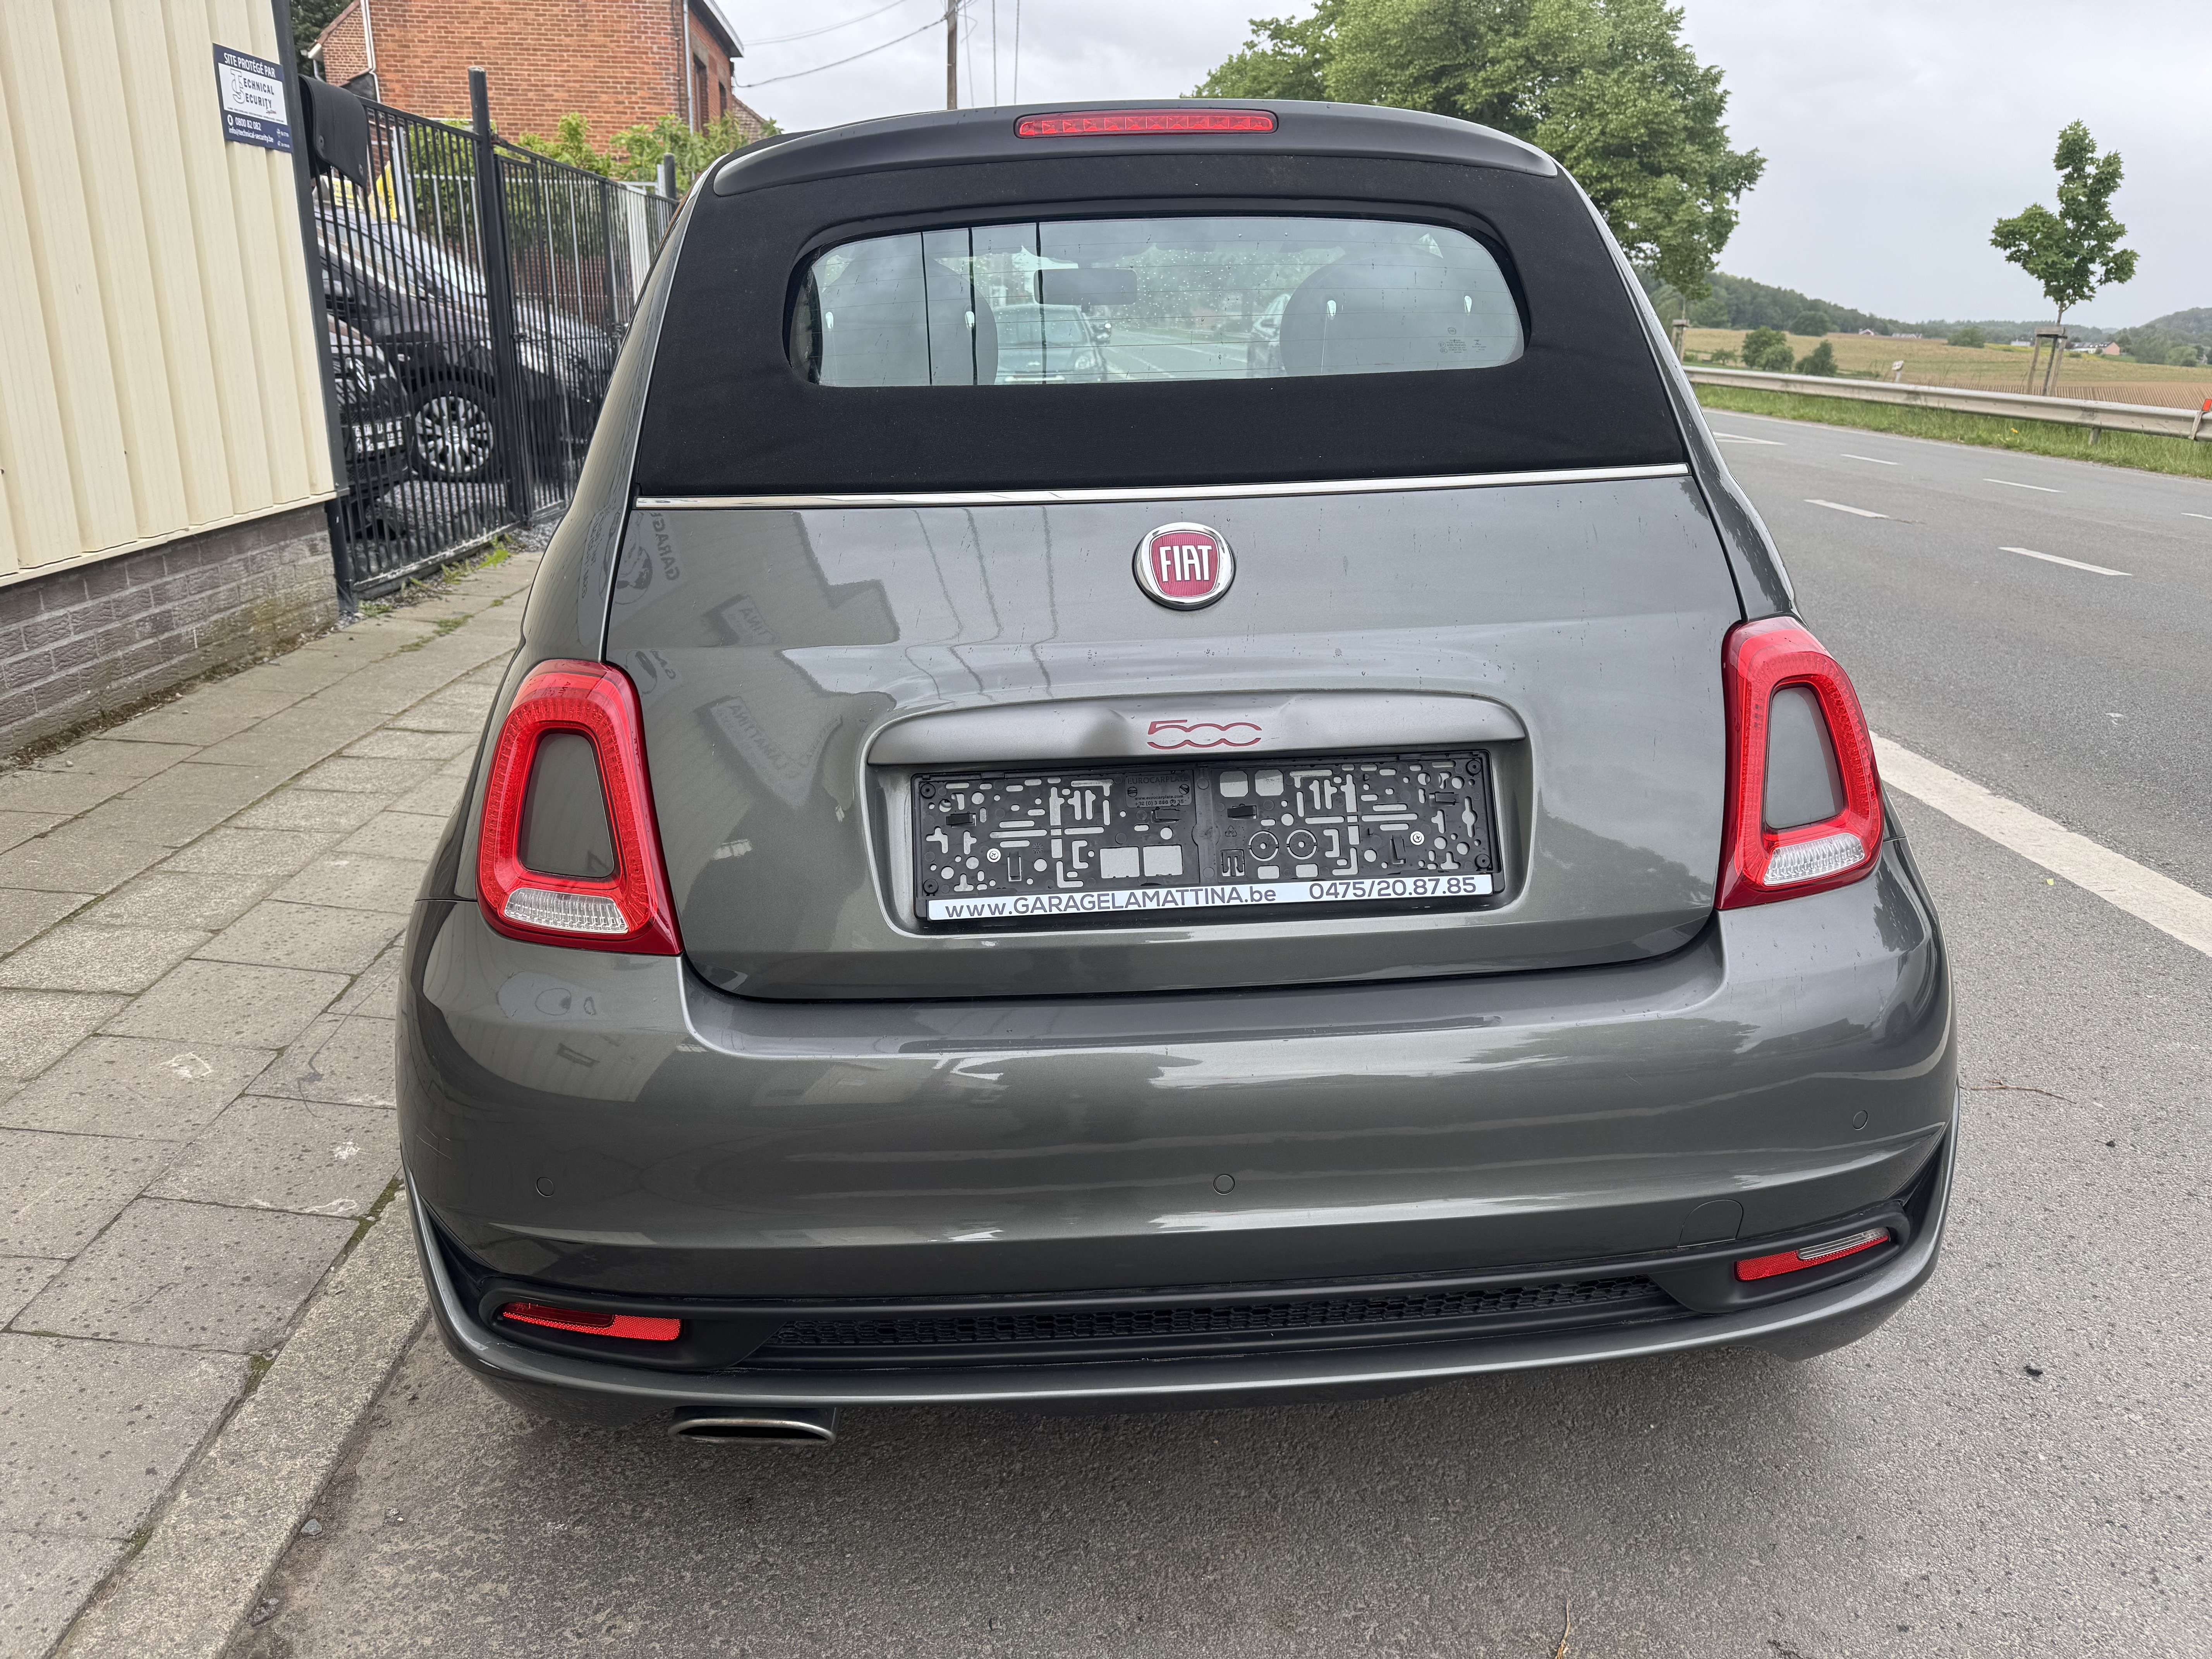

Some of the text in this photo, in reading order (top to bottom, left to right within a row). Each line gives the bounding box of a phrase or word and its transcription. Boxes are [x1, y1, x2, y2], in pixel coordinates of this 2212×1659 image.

[224, 53, 276, 78] SITE PROTÉGÉ PAR
[235, 117, 262, 131] 0800 82 082
[1159, 544, 1212, 582] FIAT
[1147, 719, 1262, 750] 500
[1128, 776, 1188, 784] EUROCARPLATE
[945, 877, 1477, 918] www.GARAGELAMATTINA.be 0475/20.87.85
